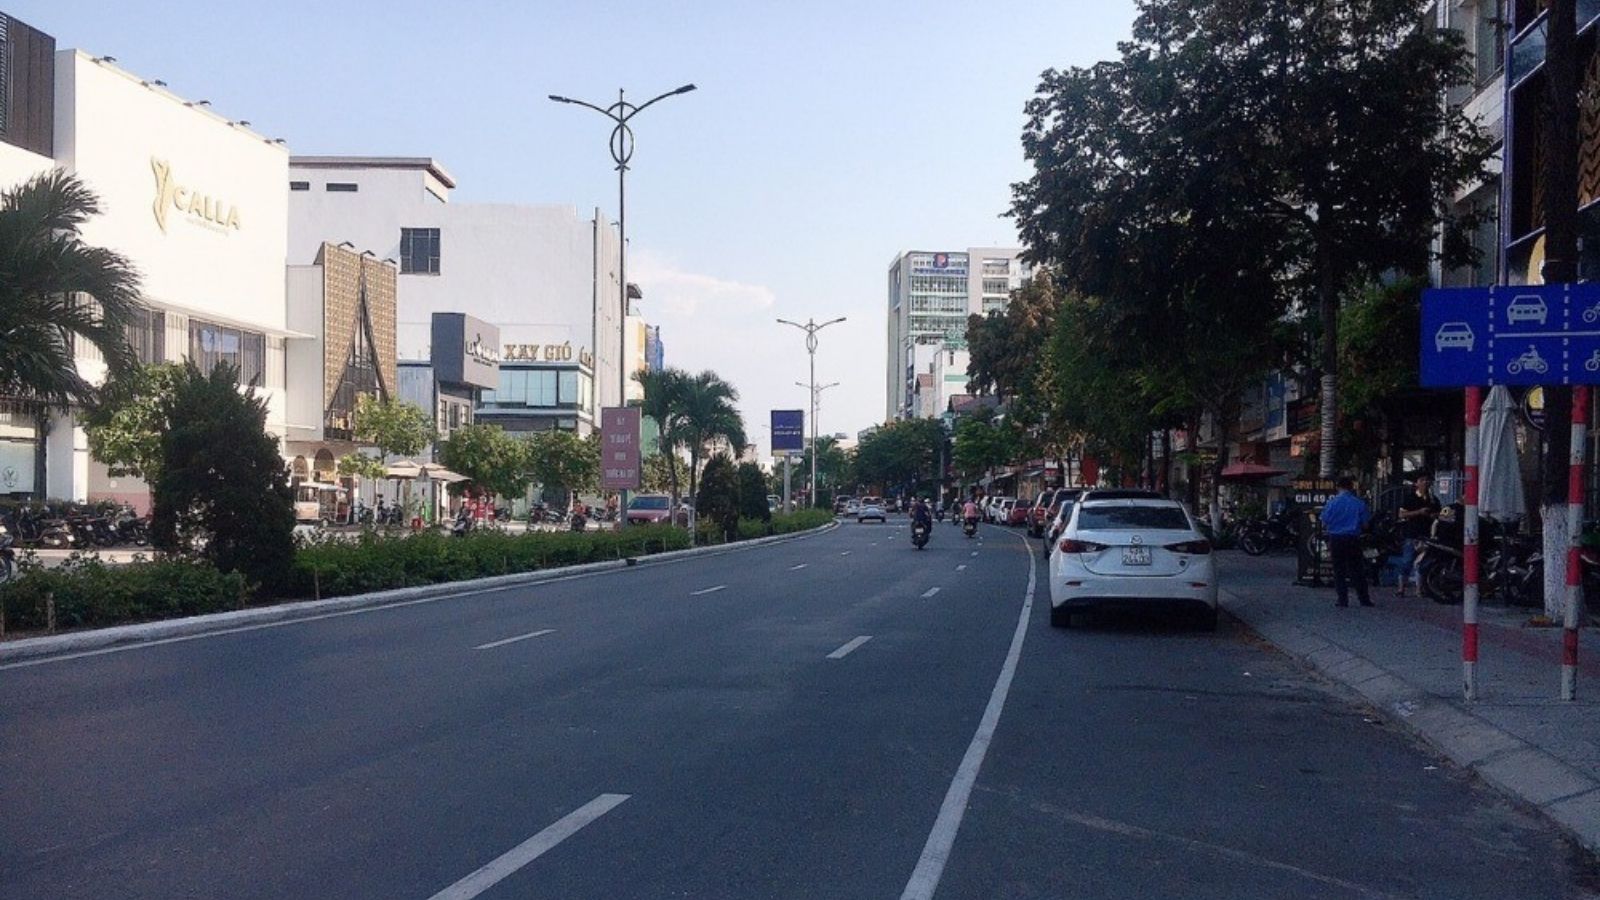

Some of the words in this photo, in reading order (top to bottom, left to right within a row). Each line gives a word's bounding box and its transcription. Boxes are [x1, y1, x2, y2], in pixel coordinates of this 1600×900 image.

[173, 186, 240, 231] CALLA
[503, 344, 540, 361] XAY
[544, 340, 572, 361] GIÓ
